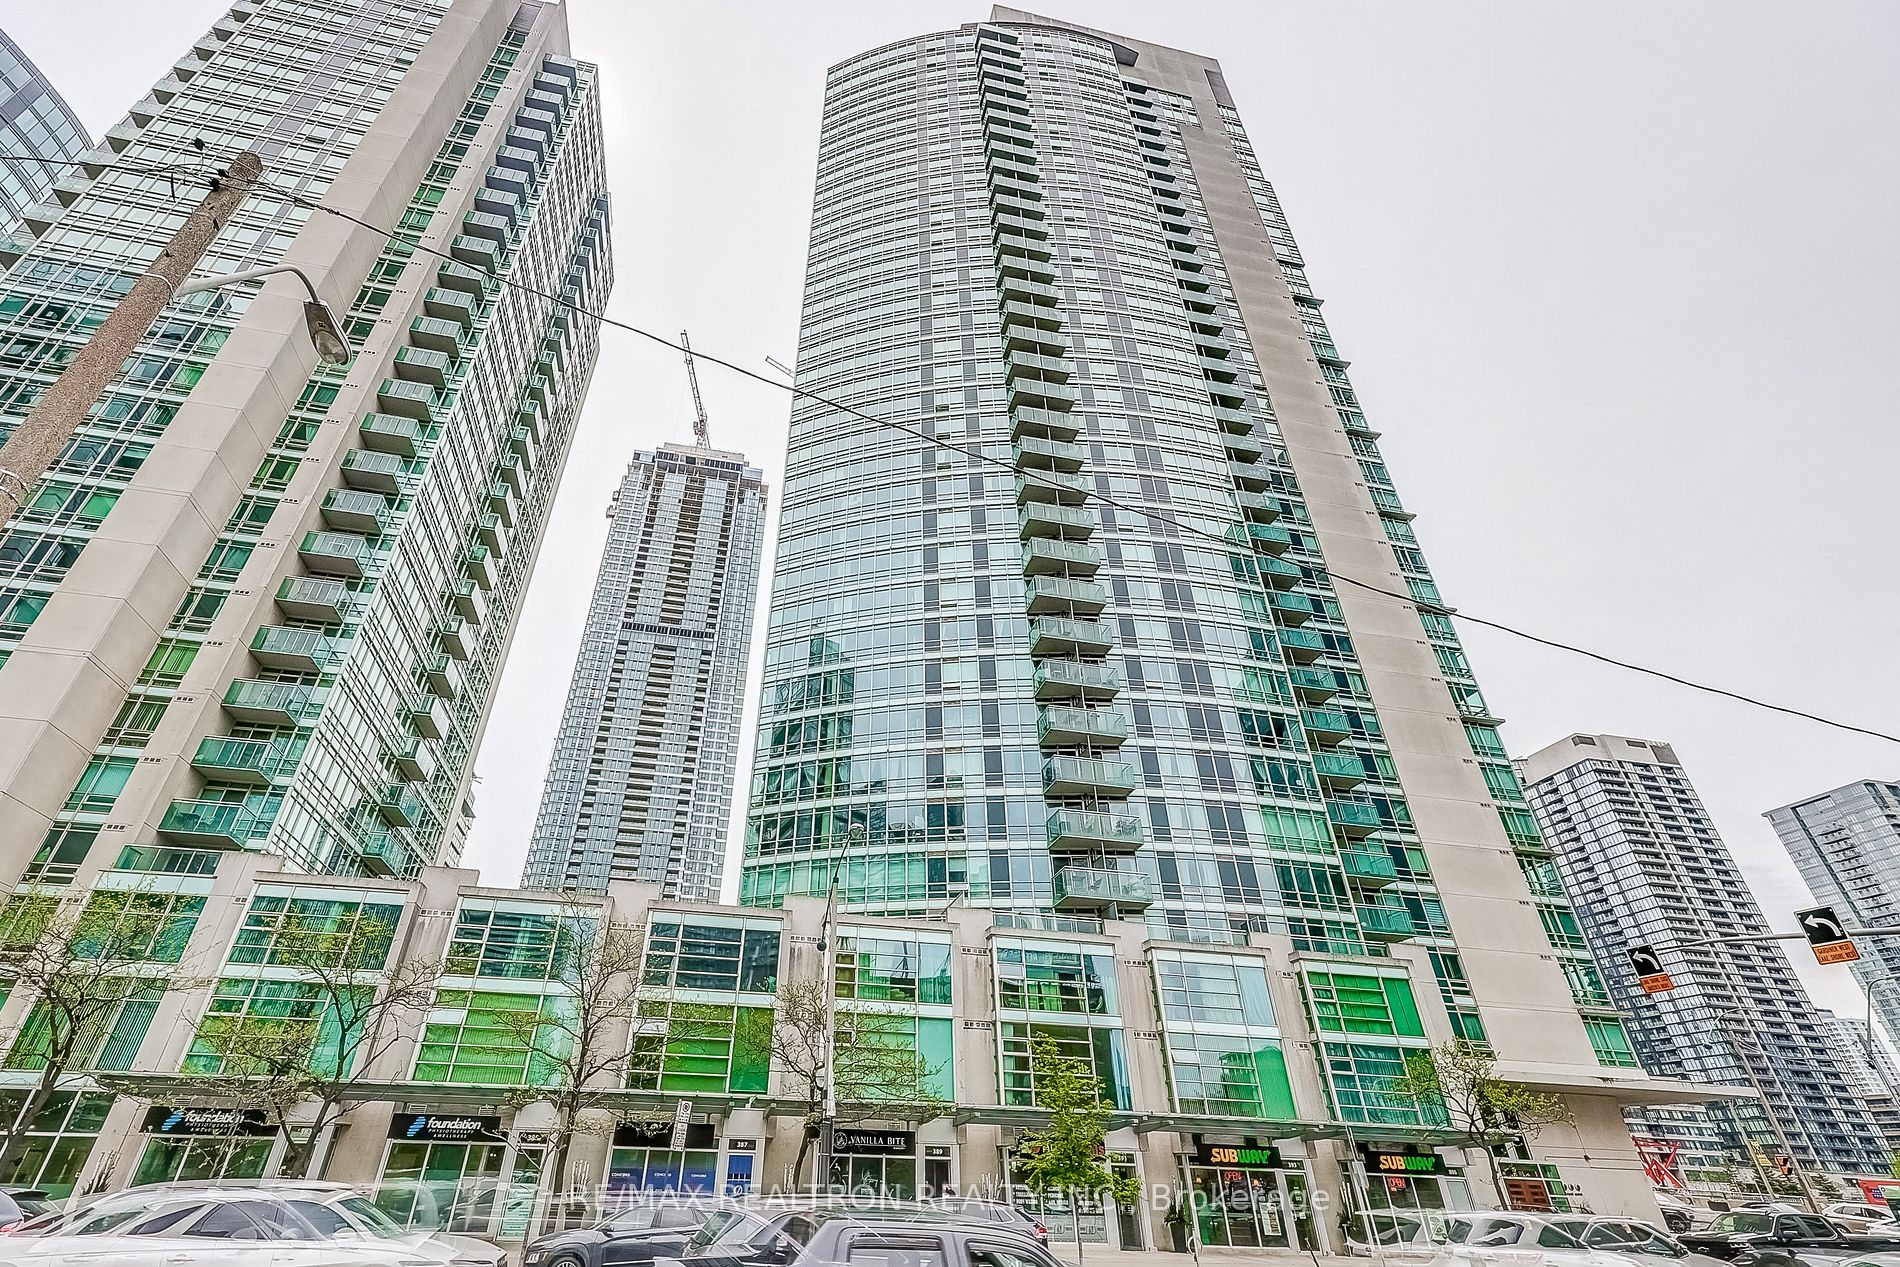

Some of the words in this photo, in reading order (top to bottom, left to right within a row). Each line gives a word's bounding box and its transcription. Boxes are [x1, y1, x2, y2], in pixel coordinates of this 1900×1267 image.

[426, 1116, 482, 1130] foundation
[850, 1135, 884, 1145] VANILLA
[887, 1136, 906, 1146] BITE
[1210, 1148, 1271, 1164] SUBWAY
[1379, 1155, 1436, 1171] SUBWAY
[1224, 1171, 1242, 1181] OPEN
